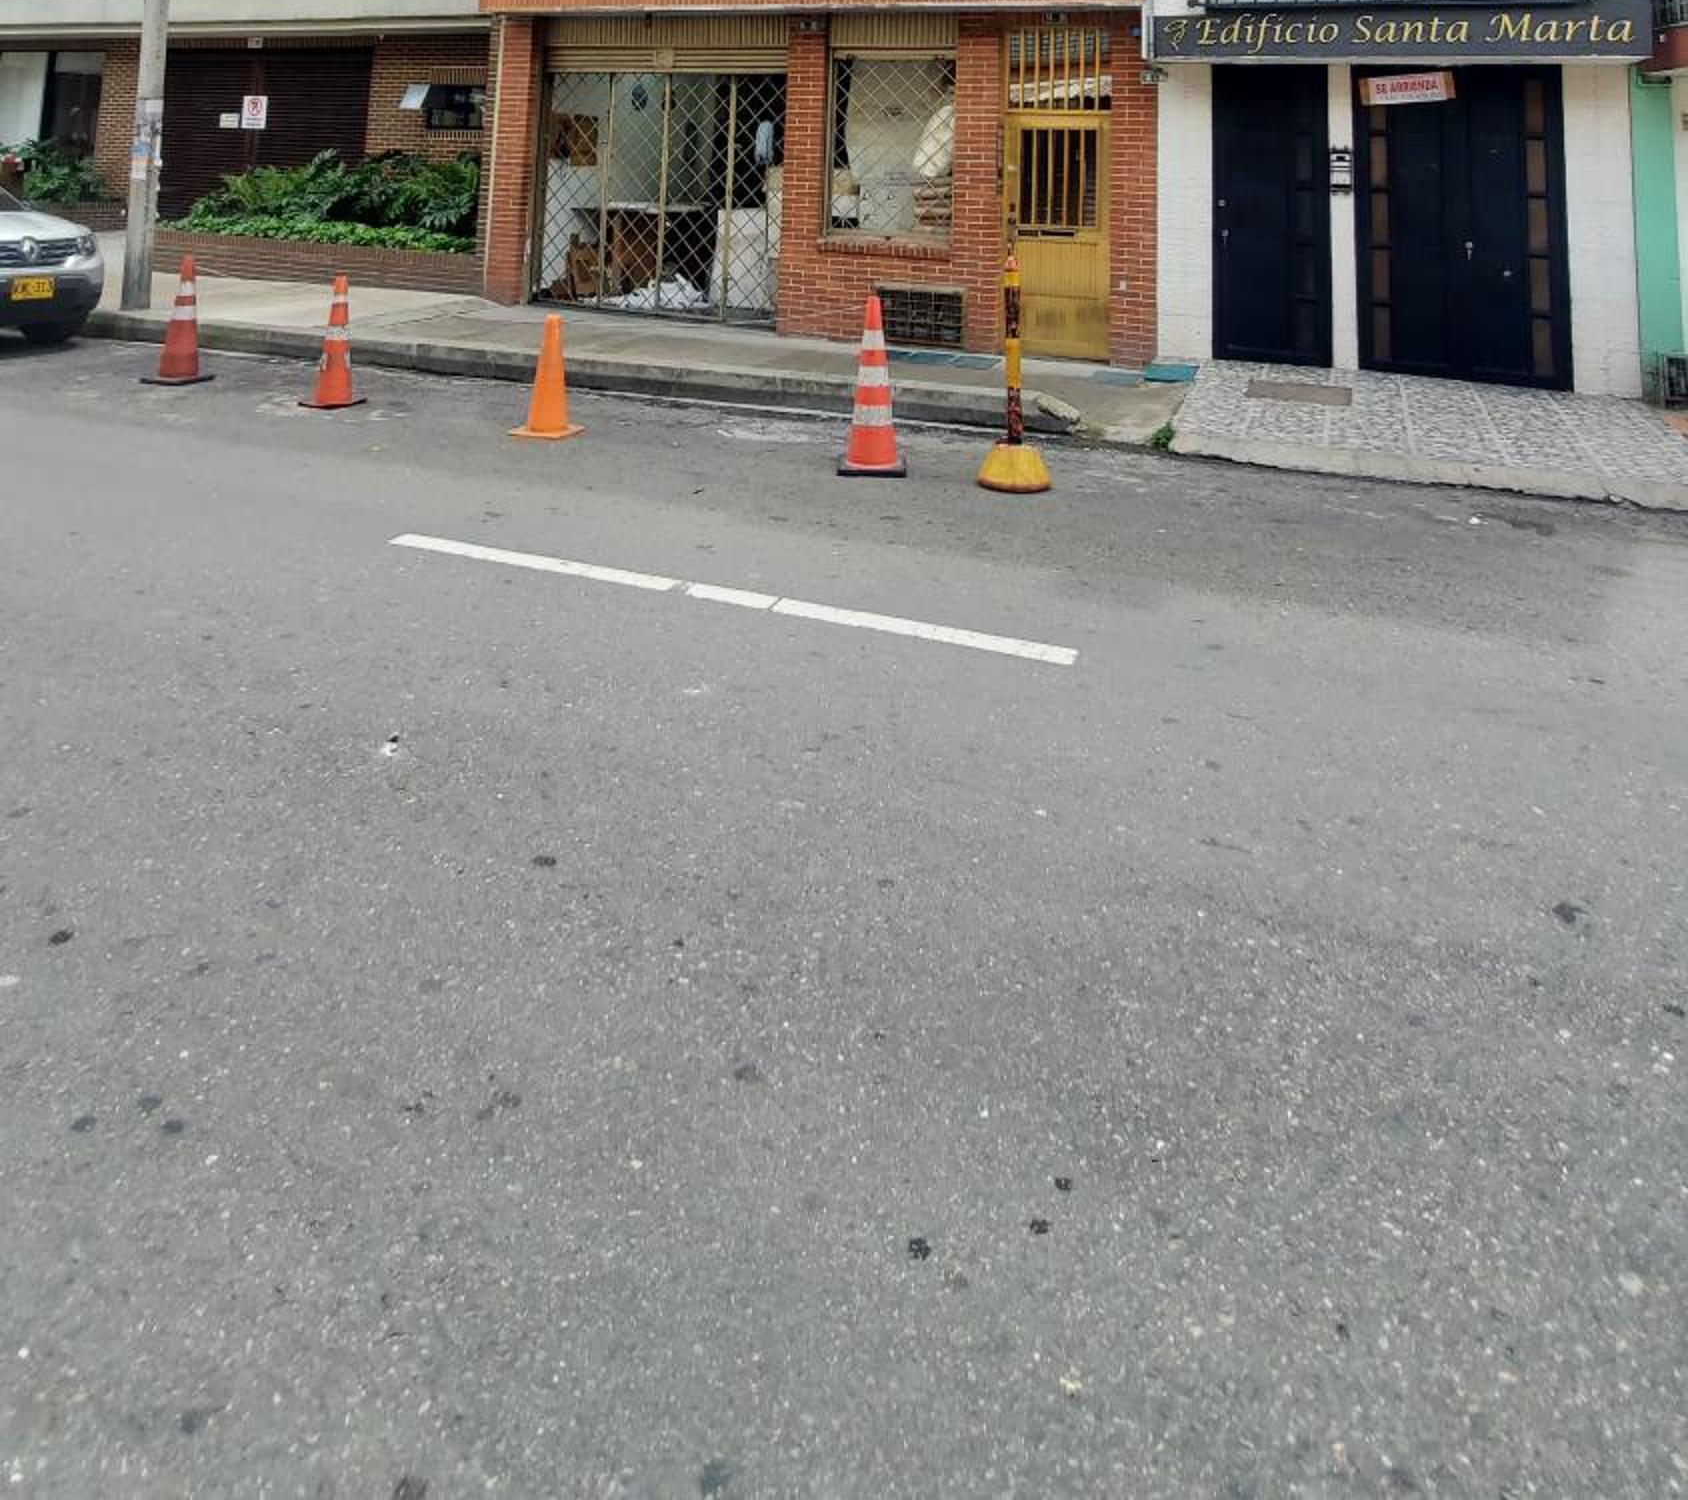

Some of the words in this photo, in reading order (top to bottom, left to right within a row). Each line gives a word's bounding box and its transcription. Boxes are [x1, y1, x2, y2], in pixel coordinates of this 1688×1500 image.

[1195, 13, 1339, 53] Edificio
[1351, 14, 1470, 43] Santa
[1485, 12, 1637, 43] Marta
